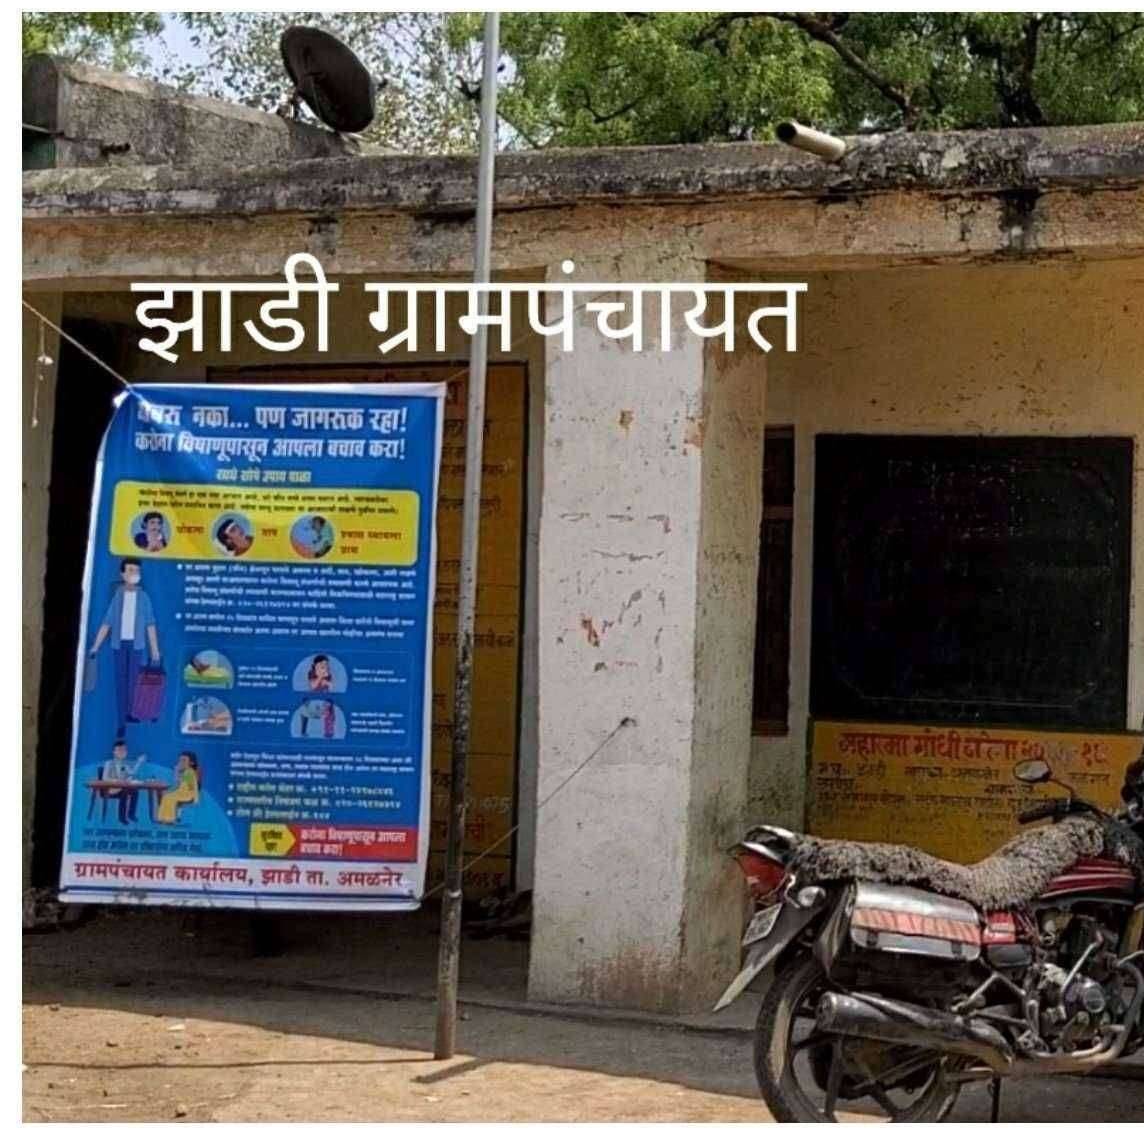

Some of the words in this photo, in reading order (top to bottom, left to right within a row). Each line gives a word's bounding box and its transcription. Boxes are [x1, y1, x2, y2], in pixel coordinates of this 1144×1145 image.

[255, 407, 287, 430] पण
[368, 407, 408, 434] रहा!
[271, 437, 323, 458] आपला
[74, 858, 166, 879] ग्रामपंचायत
[261, 864, 301, 885] झाडी
